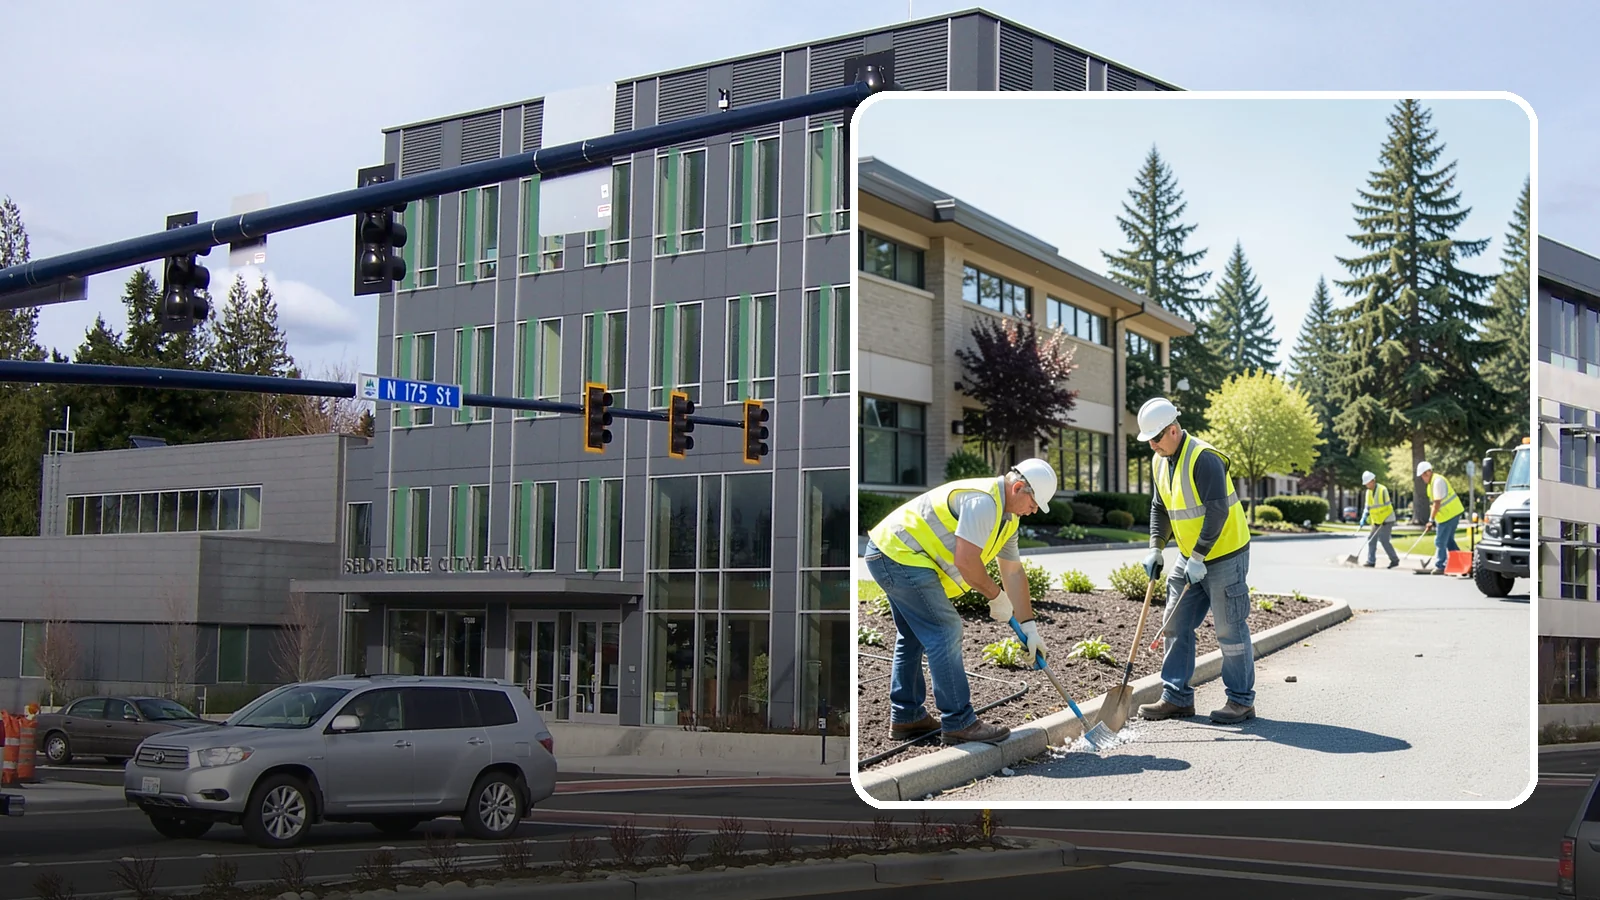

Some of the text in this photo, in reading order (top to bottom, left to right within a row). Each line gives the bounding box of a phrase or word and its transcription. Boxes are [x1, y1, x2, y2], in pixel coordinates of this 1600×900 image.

[387, 380, 451, 406] N 175 St
[343, 555, 527, 574] SHORELINE CITY HALL
